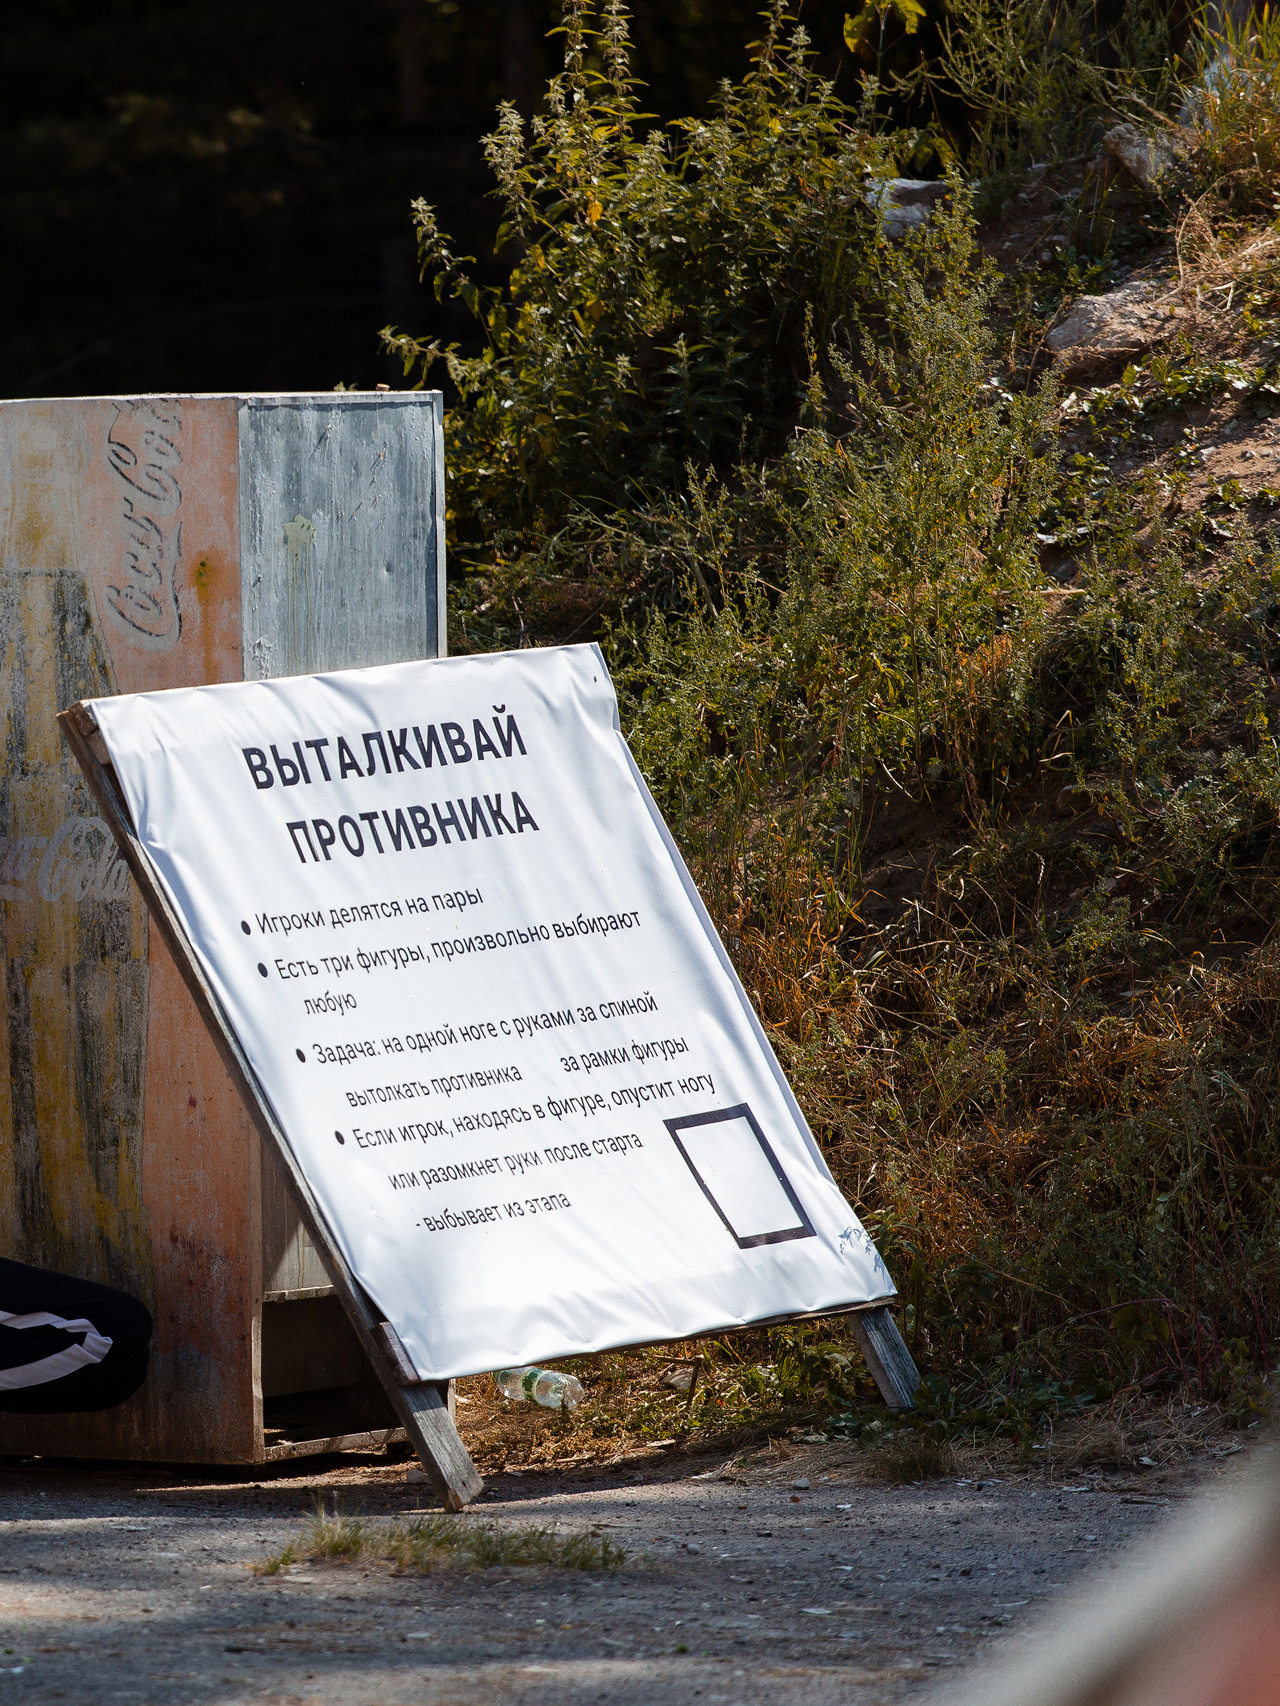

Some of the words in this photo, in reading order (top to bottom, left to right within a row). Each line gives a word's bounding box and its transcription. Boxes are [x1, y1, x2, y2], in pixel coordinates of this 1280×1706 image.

[241, 704, 527, 789] ВЫТАЛКИВАЙ
[286, 791, 540, 863] ПРОТИВНИКА
[255, 911, 325, 937] Игроки
[329, 901, 403, 929] делятся
[405, 897, 430, 914] на
[431, 888, 483, 912] пары
[274, 959, 319, 979] Есть
[320, 955, 354, 978] три
[357, 945, 430, 973] фигуры,
[430, 925, 550, 962] произвольно
[552, 911, 640, 938] выбирают
[304, 990, 357, 1016] любую
[312, 1039, 384, 1065] Задача:
[384, 1037, 404, 1054] на
[406, 1023, 458, 1053] одной
[458, 1023, 498, 1042] ноге
[500, 1020, 511, 1035] с
[512, 1009, 576, 1038] руками
[577, 1006, 598, 1022] за
[599, 991, 658, 1019] спиной
[345, 1081, 430, 1107] вытолкать
[430, 1066, 523, 1098] противника
[560, 1056, 581, 1072] за
[580, 1042, 631, 1074] рамки
[631, 1037, 689, 1065] фигуры
[352, 1128, 397, 1148] Если
[398, 1120, 454, 1144] игрок,
[452, 1107, 531, 1132] находясь
[532, 1104, 545, 1119] в
[547, 1094, 611, 1121] фигуре,
[611, 1081, 675, 1108] опустит
[677, 1074, 715, 1094] ногу
[388, 1172, 420, 1190] или
[419, 1158, 502, 1190] разомкнет
[504, 1151, 542, 1175] руки
[543, 1142, 591, 1163] после
[592, 1134, 643, 1156] старта
[423, 1206, 502, 1231] выбывает
[503, 1202, 524, 1218] из
[525, 1193, 572, 1214] этапа
